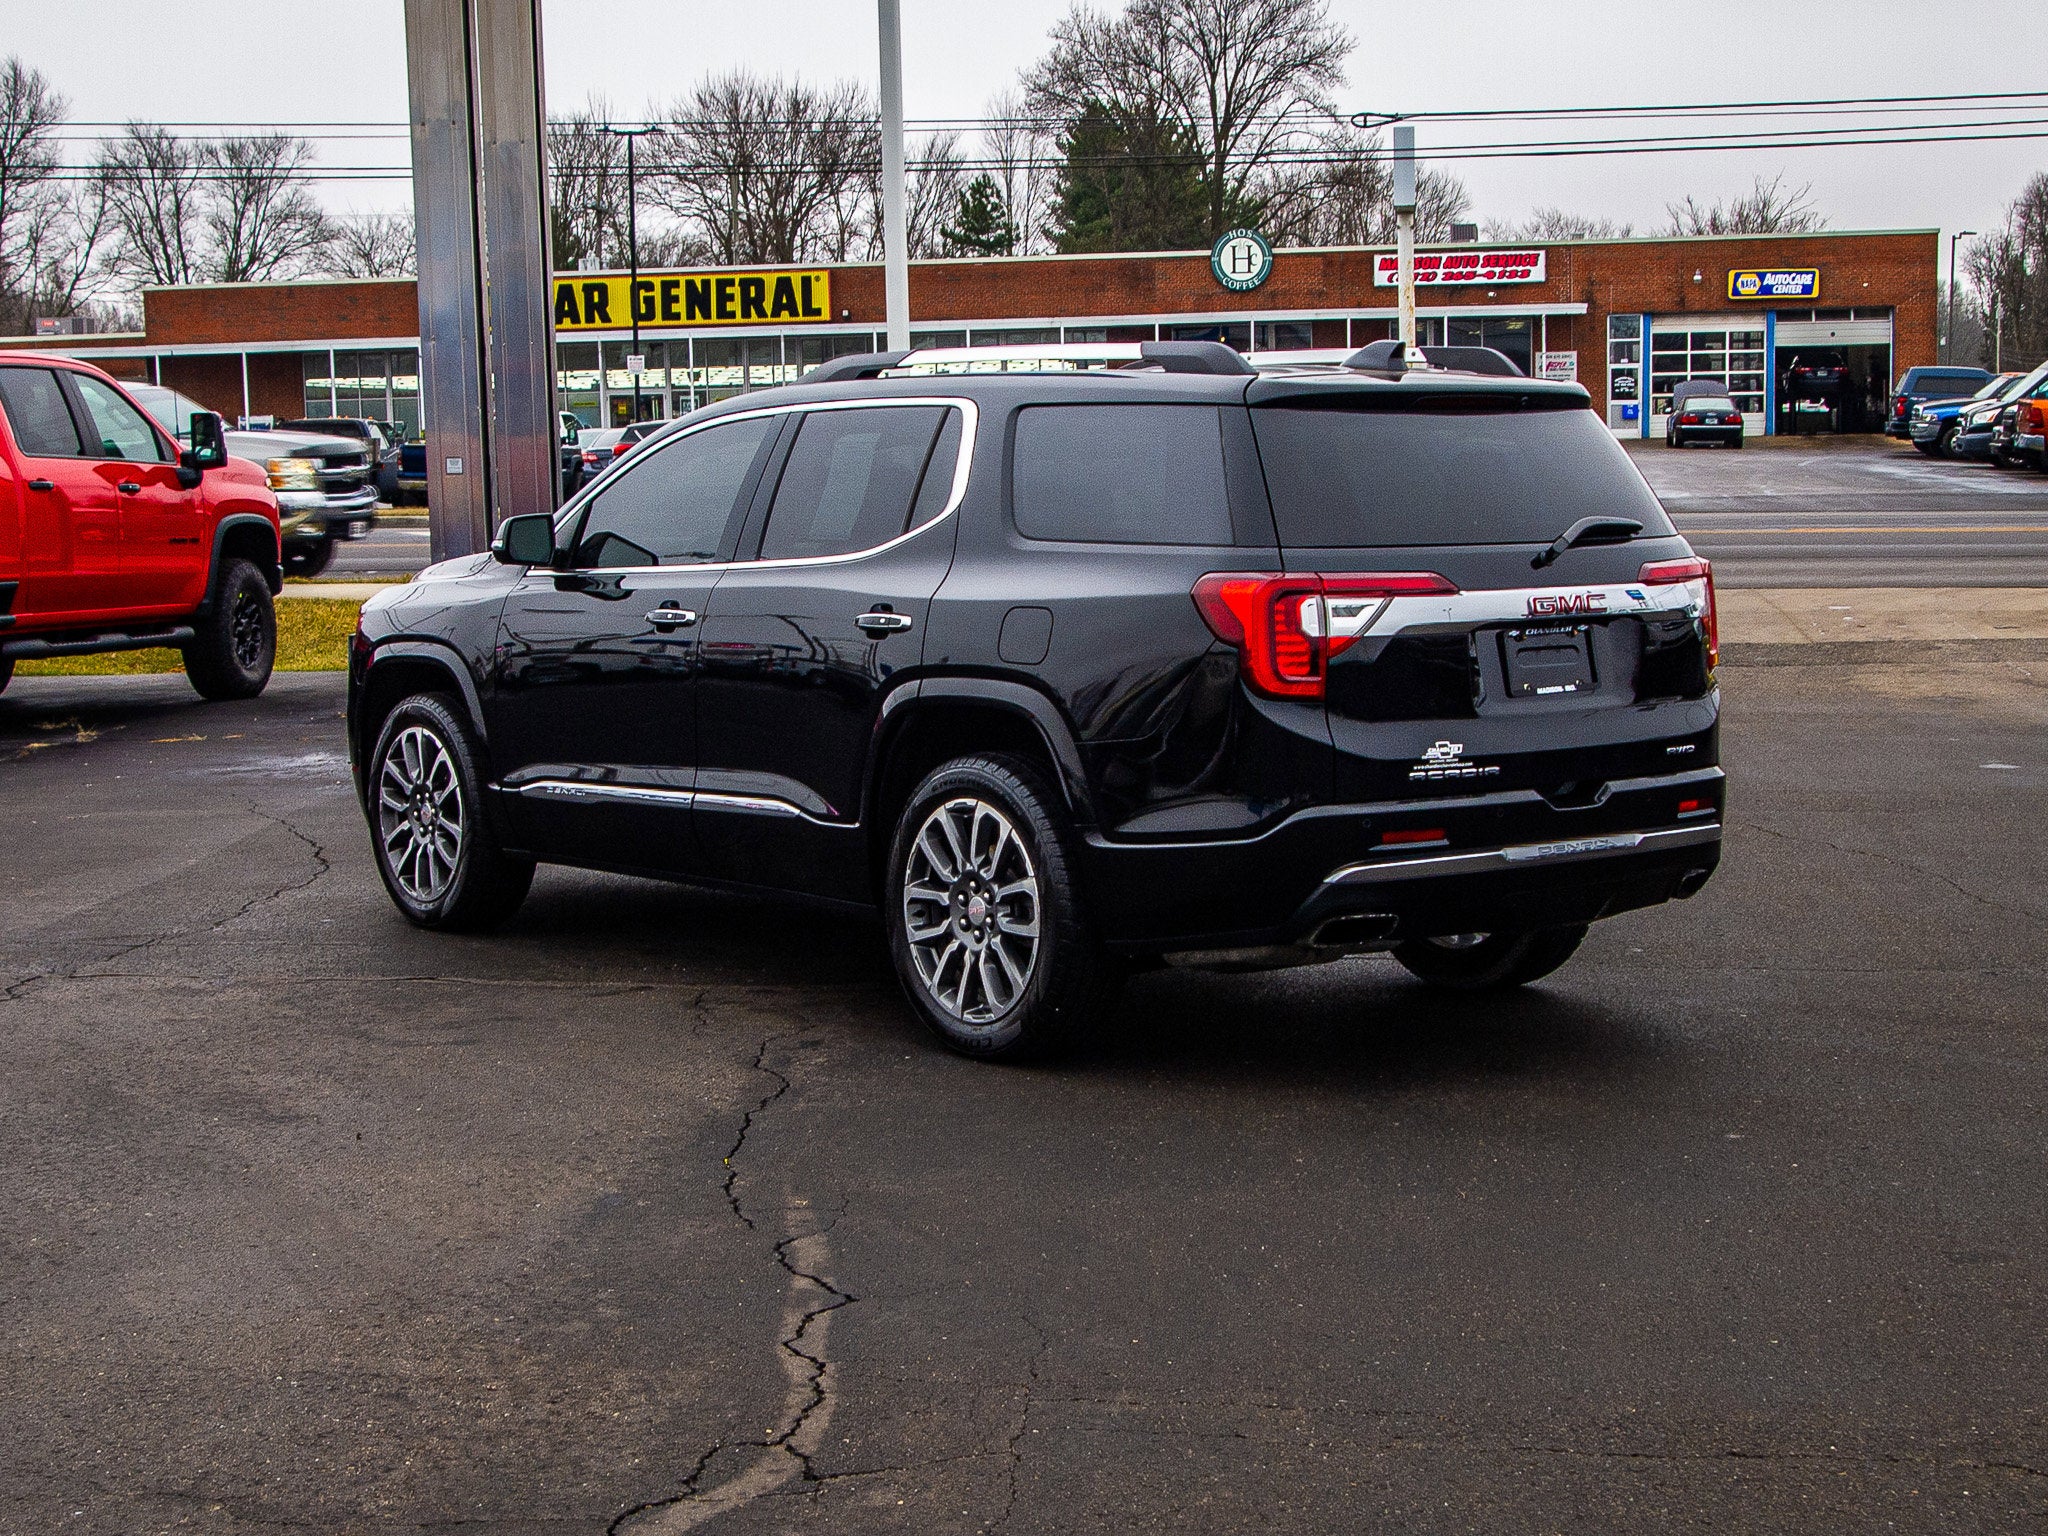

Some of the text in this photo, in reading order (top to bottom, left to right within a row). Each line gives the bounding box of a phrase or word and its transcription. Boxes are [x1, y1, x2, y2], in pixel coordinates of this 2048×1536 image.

[1229, 228, 1253, 239] HOS
[1443, 254, 1480, 269] AUTO
[1481, 253, 1540, 268] SERVICE
[1222, 276, 1261, 290] COFFEE
[1740, 279, 1757, 289] NAPA
[1772, 285, 1803, 294] CENTER
[630, 275, 822, 322] GENERAL
[1529, 593, 1607, 616] GMC
[1525, 626, 1573, 636] CHANDLER
[1409, 766, 1500, 780] ACADIA
